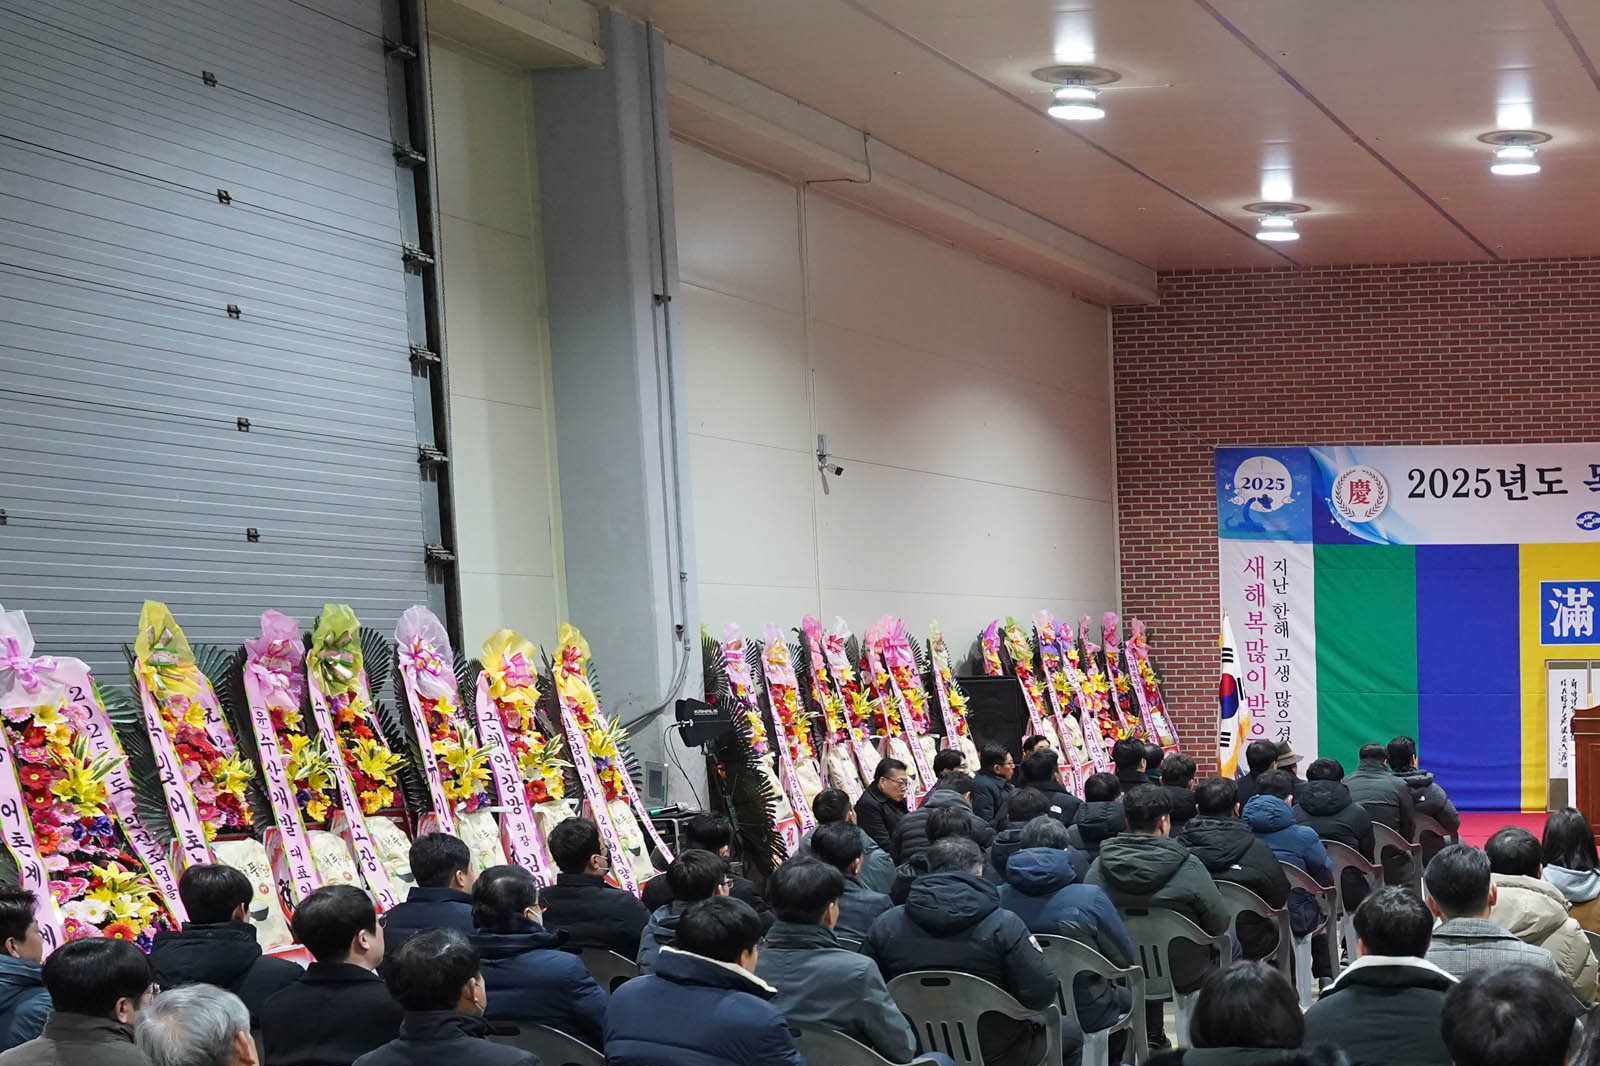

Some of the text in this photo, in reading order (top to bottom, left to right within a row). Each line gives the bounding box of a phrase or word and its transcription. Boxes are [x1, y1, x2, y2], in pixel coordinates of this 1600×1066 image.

[1240, 476, 1286, 491] 2025
[1348, 479, 1372, 506] 慶
[1407, 462, 1569, 501] 2025년도
[1272, 558, 1289, 595] 지난
[1273, 602, 1291, 639] 한해
[1549, 587, 1595, 637] 滿
[1273, 647, 1292, 683] 고생
